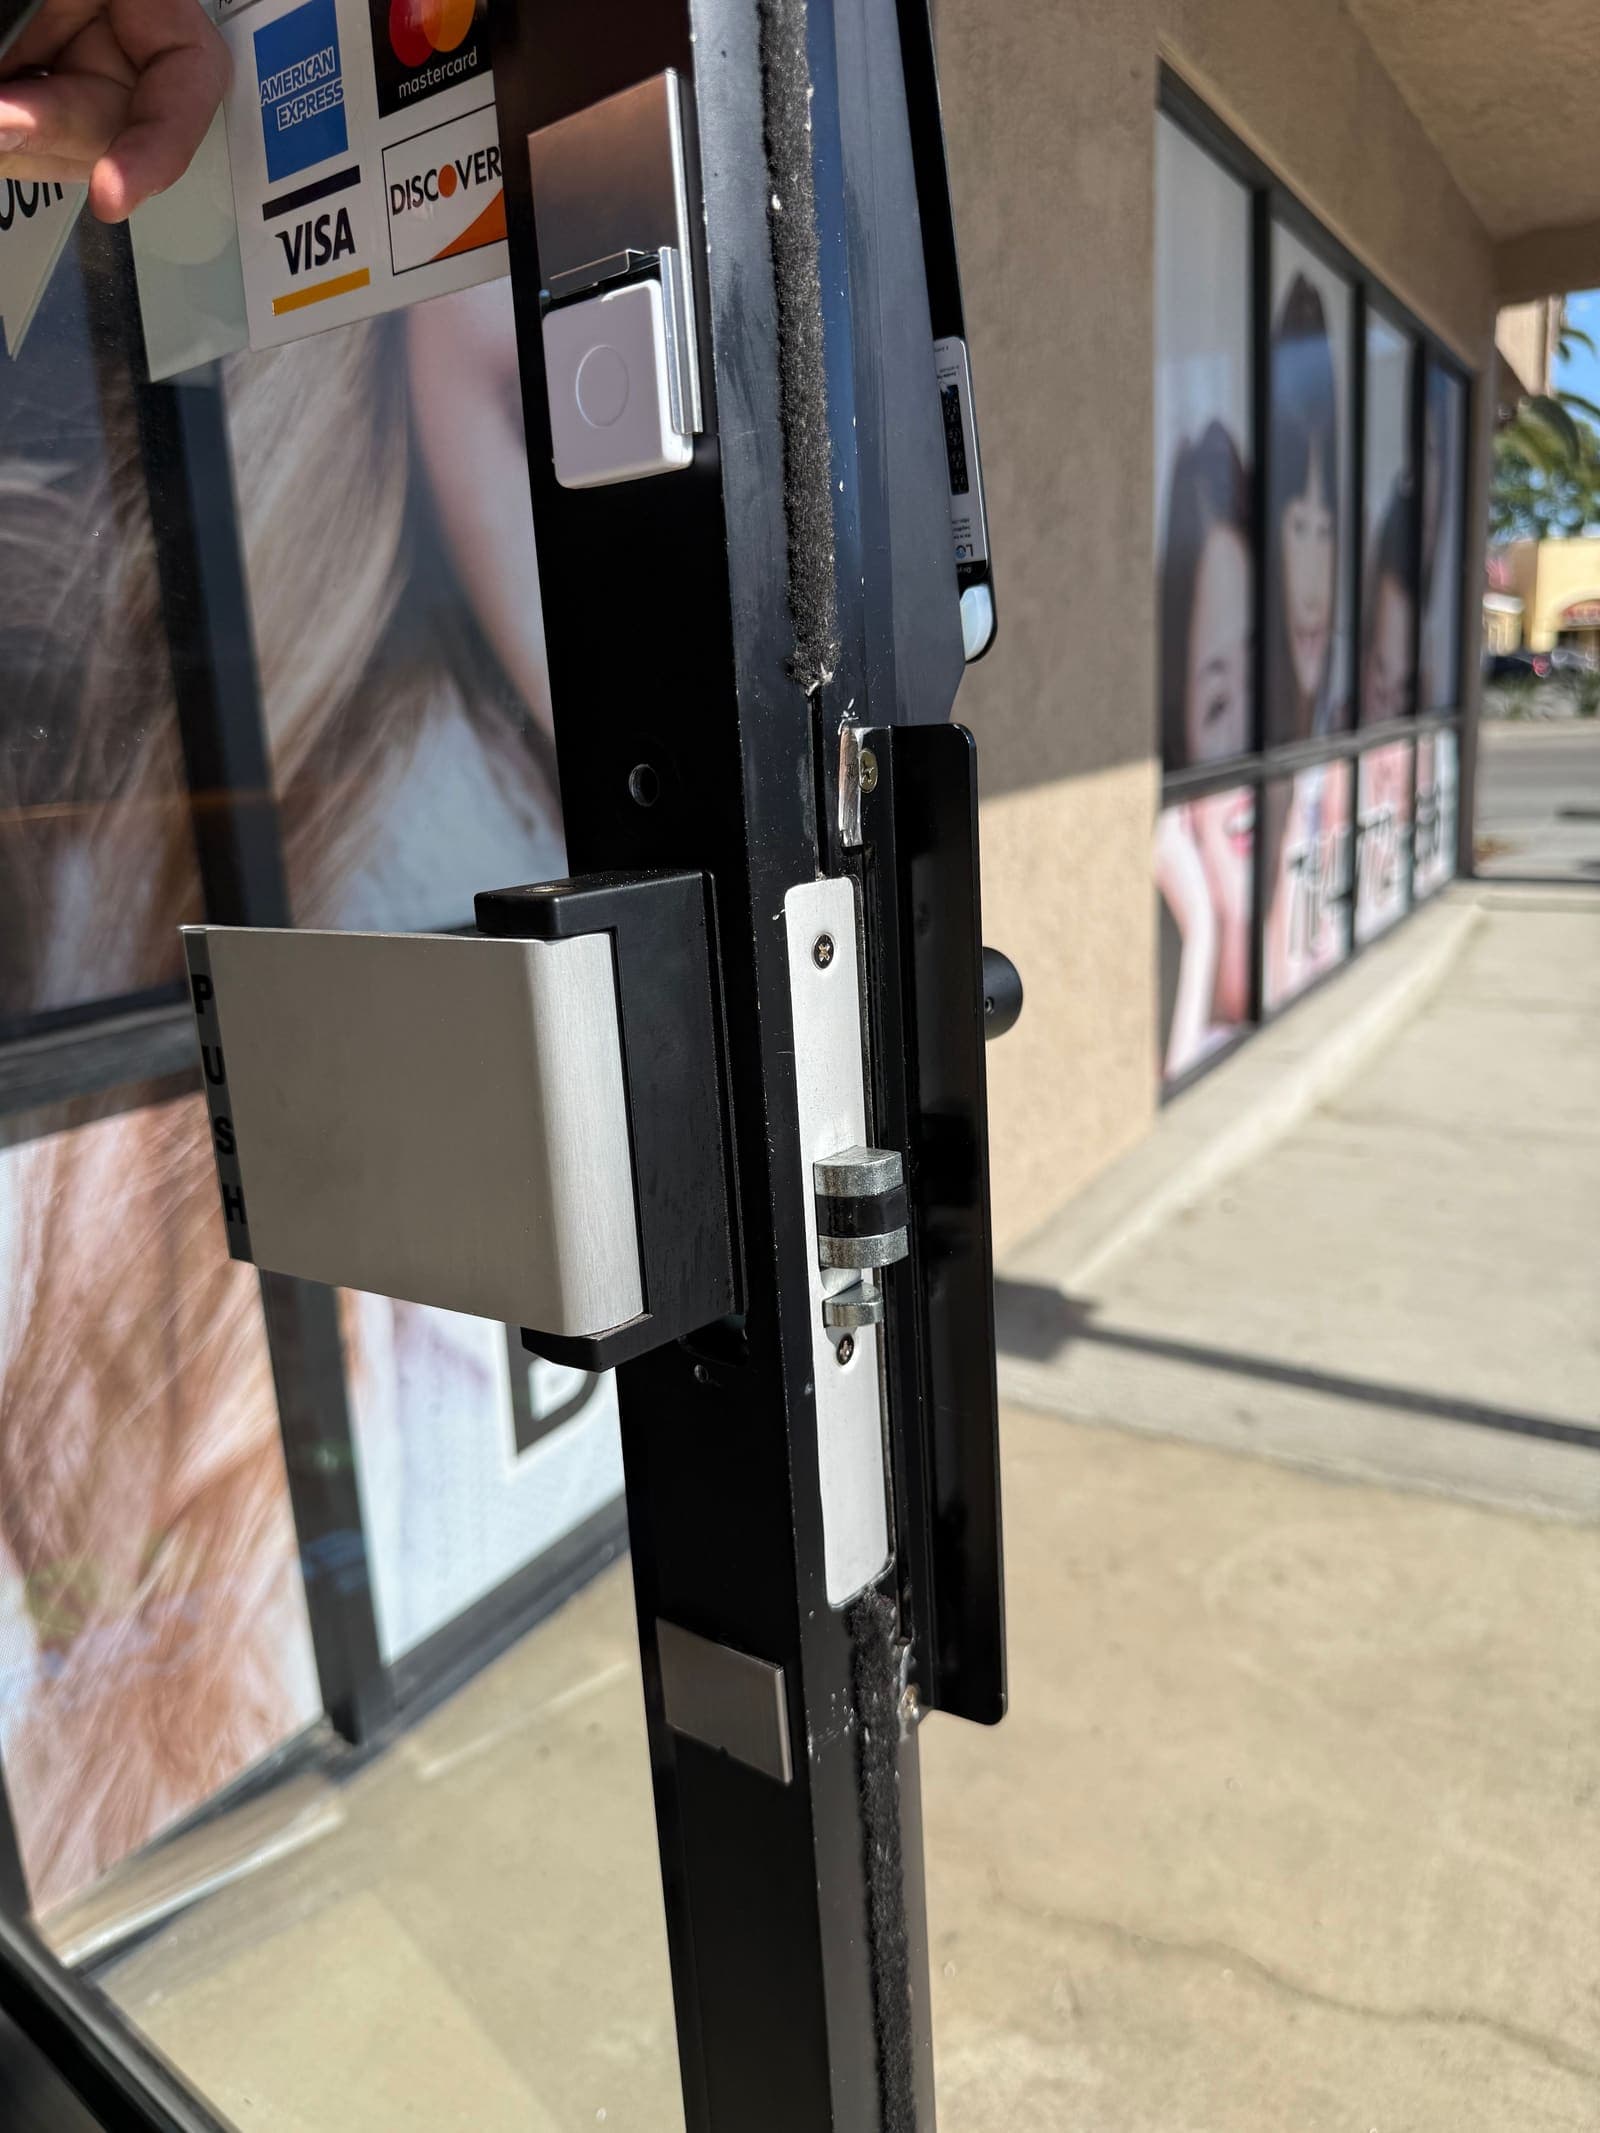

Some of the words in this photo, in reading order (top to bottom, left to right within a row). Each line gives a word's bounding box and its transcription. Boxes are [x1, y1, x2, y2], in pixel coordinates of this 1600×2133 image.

[260, 46, 335, 106] AMERICAN
[398, 45, 478, 98] mastercard
[277, 77, 344, 131] EXPRESS
[390, 145, 502, 216] DISCOVER
[275, 207, 356, 276] VISA
[191, 974, 247, 1224] PUSH
